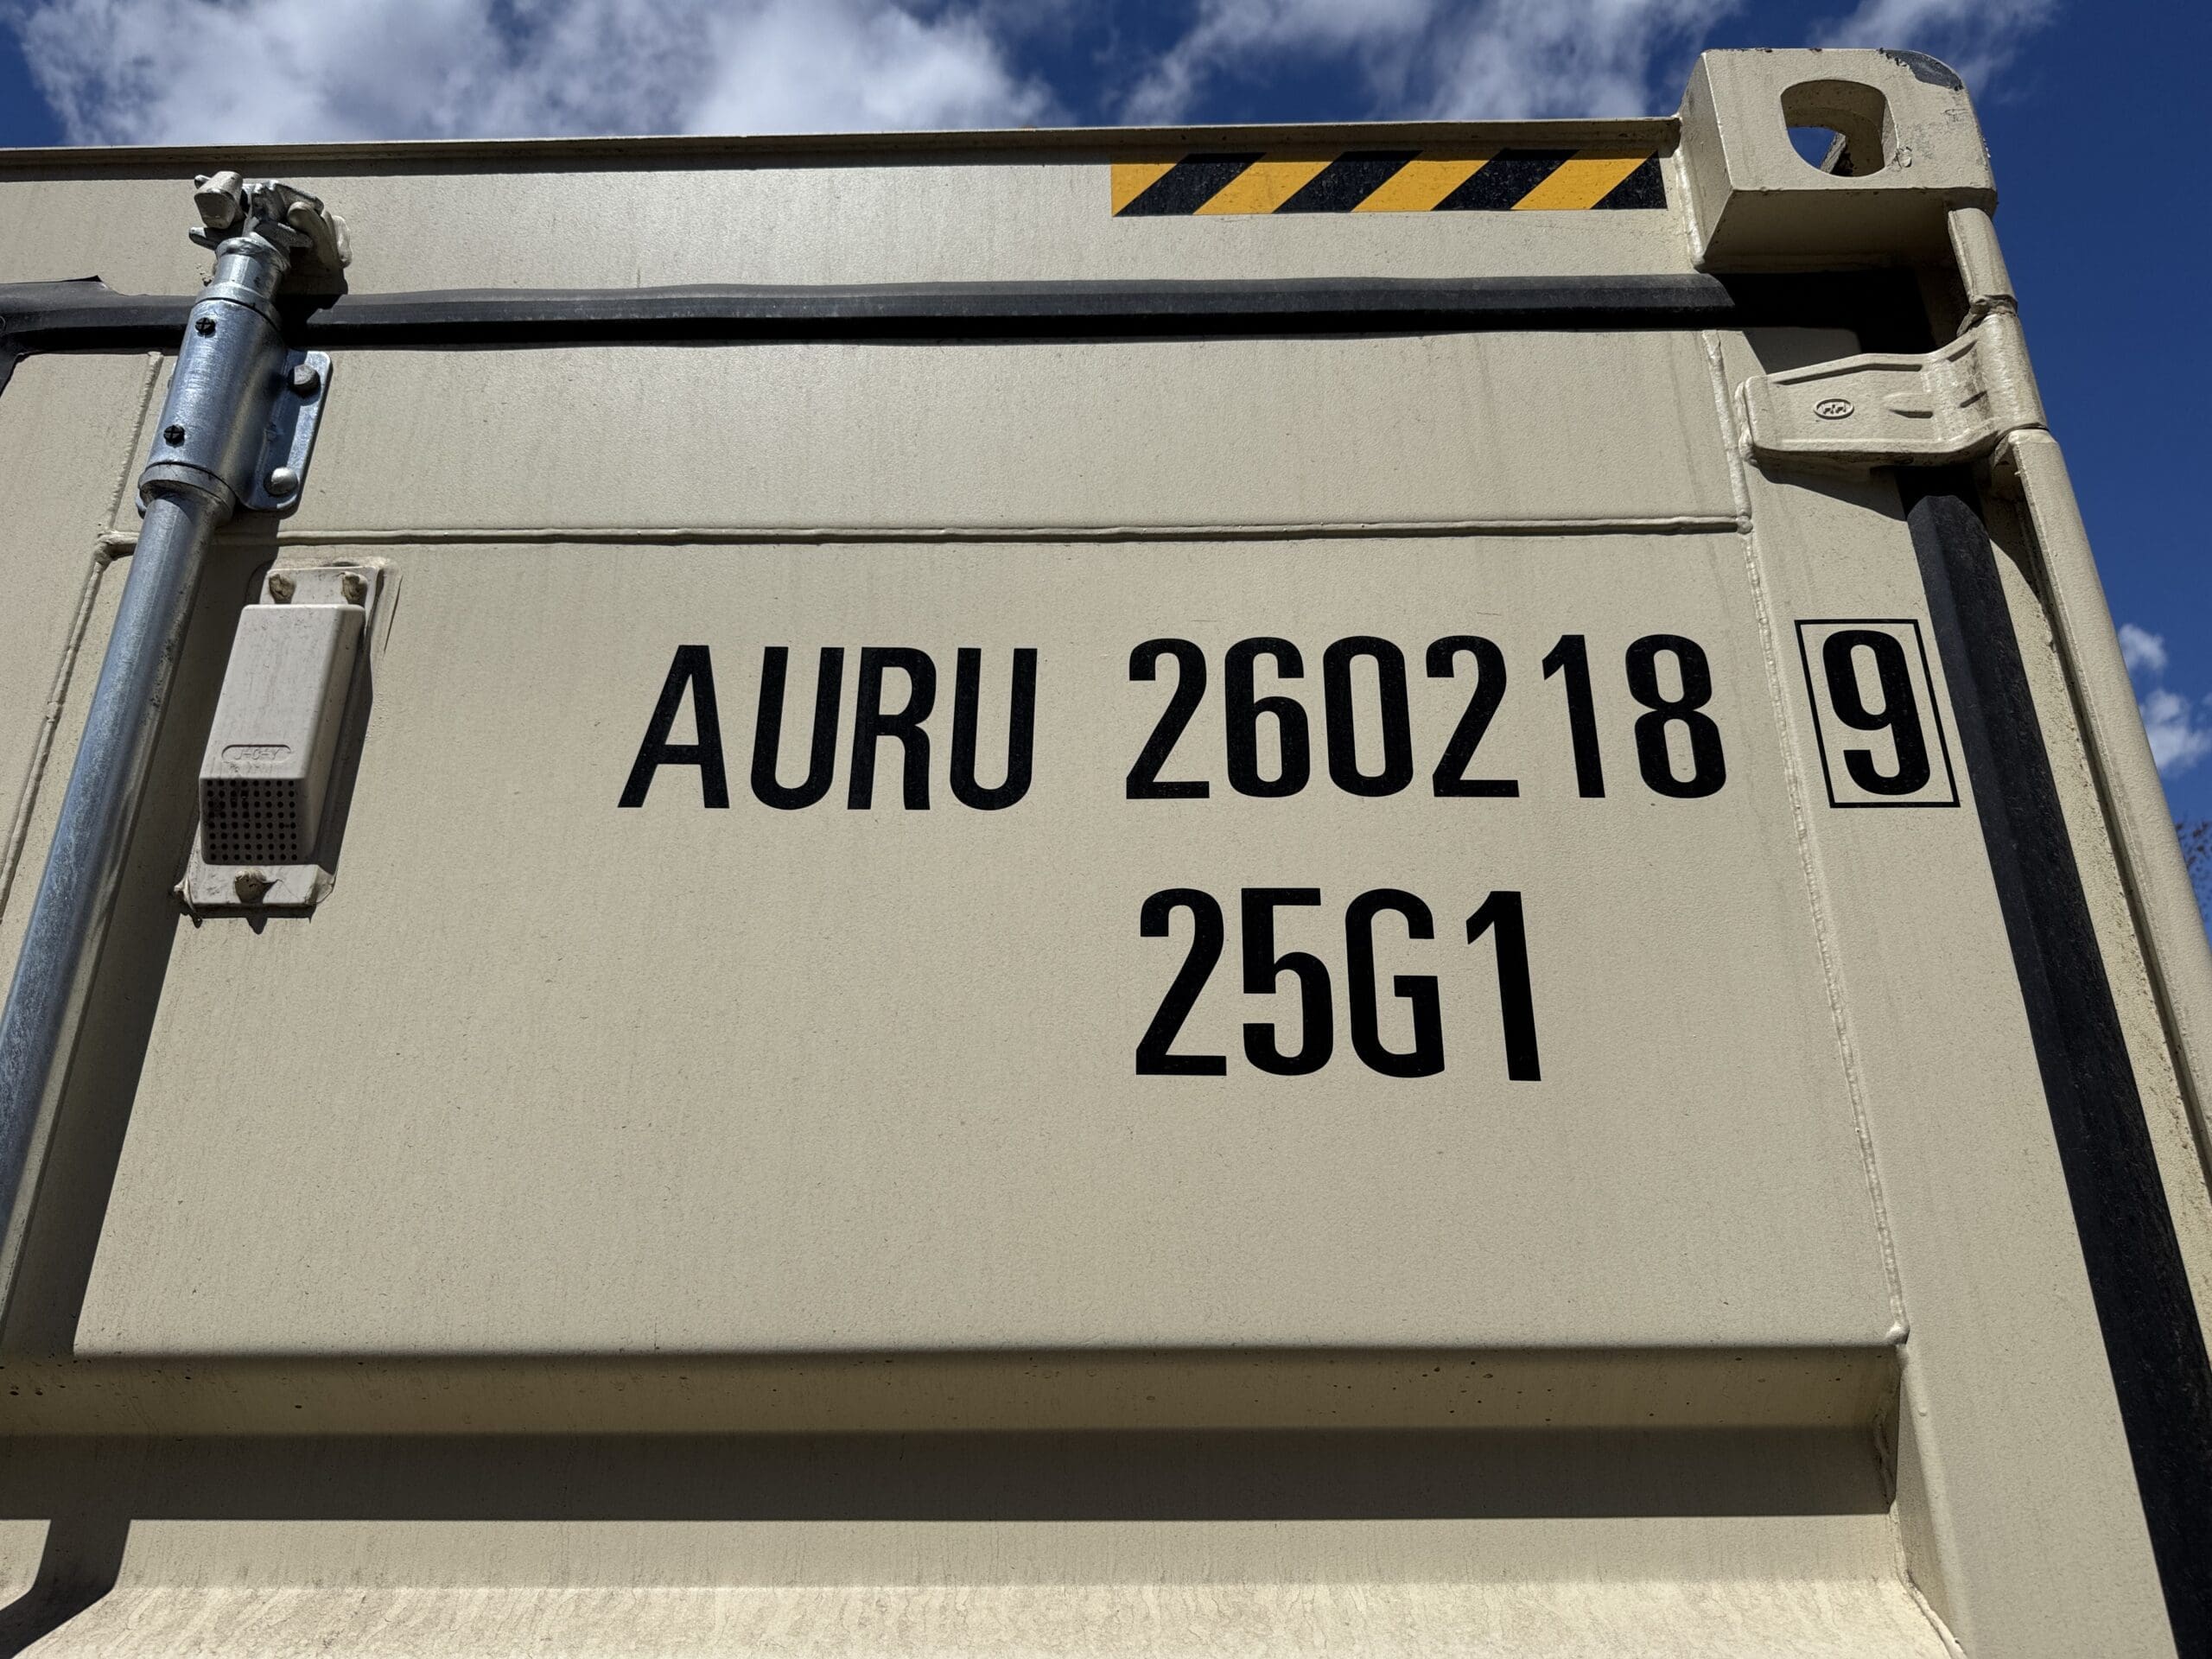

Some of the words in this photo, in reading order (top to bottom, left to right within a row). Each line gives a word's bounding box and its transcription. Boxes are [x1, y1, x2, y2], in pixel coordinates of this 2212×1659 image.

[618, 645, 1037, 810] AURU
[1127, 634, 1726, 799] 260218
[1823, 630, 1931, 796] 9
[1136, 888, 1541, 1081] 25G1
